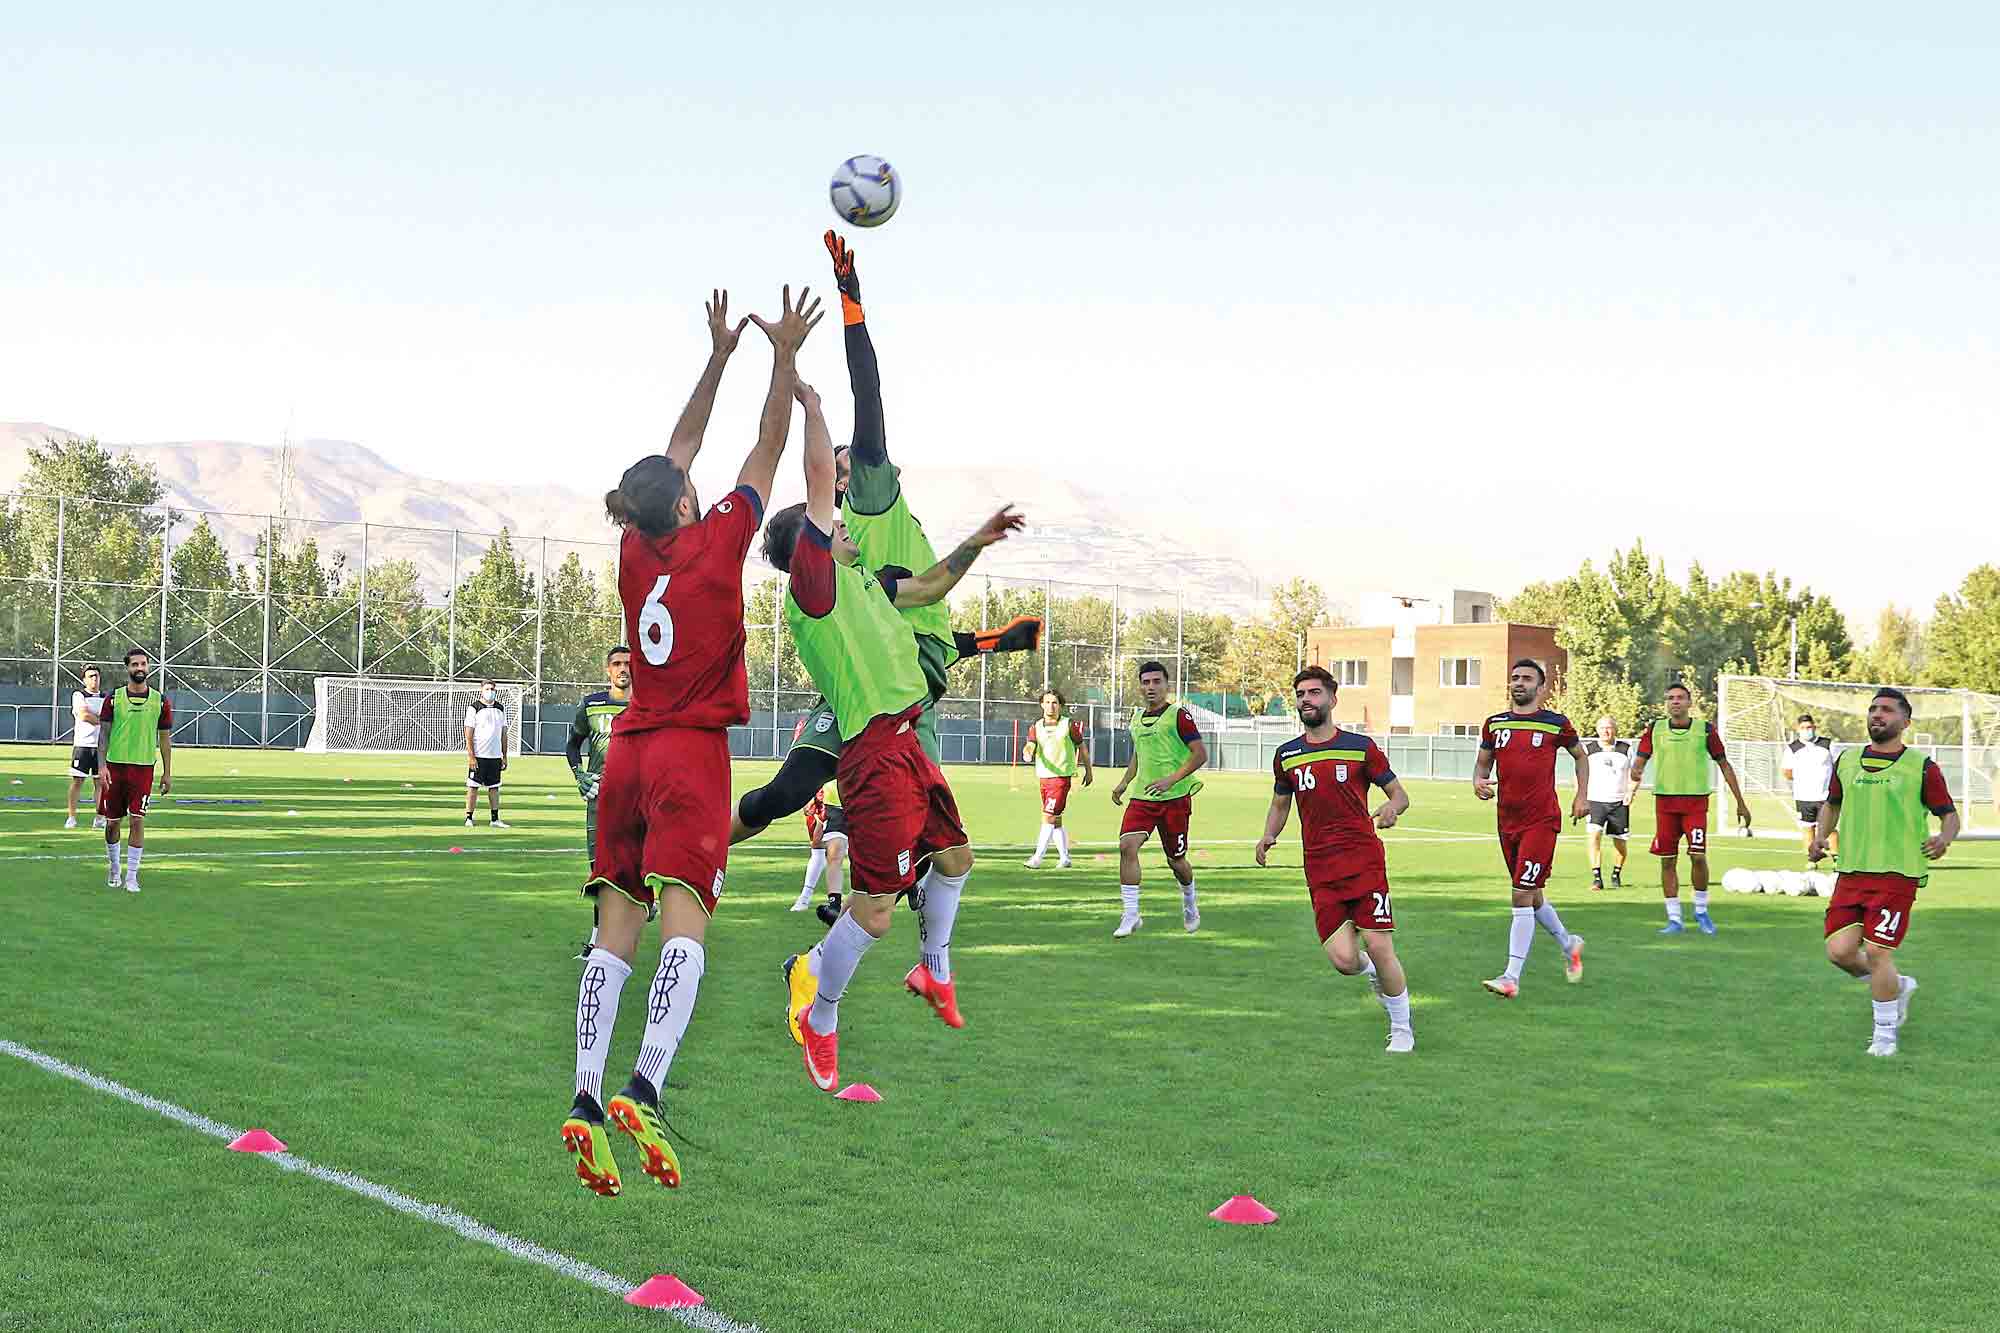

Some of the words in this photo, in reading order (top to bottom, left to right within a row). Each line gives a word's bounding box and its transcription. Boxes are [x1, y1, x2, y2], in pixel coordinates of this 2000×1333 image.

[638, 574, 674, 666] 6
[1494, 729, 1512, 749] 29
[1294, 765, 1316, 792] 26
[1177, 833, 1185, 852] 5
[1690, 828, 1704, 844] 13
[1520, 860, 1541, 881] 29
[1874, 908, 1902, 934] 24
